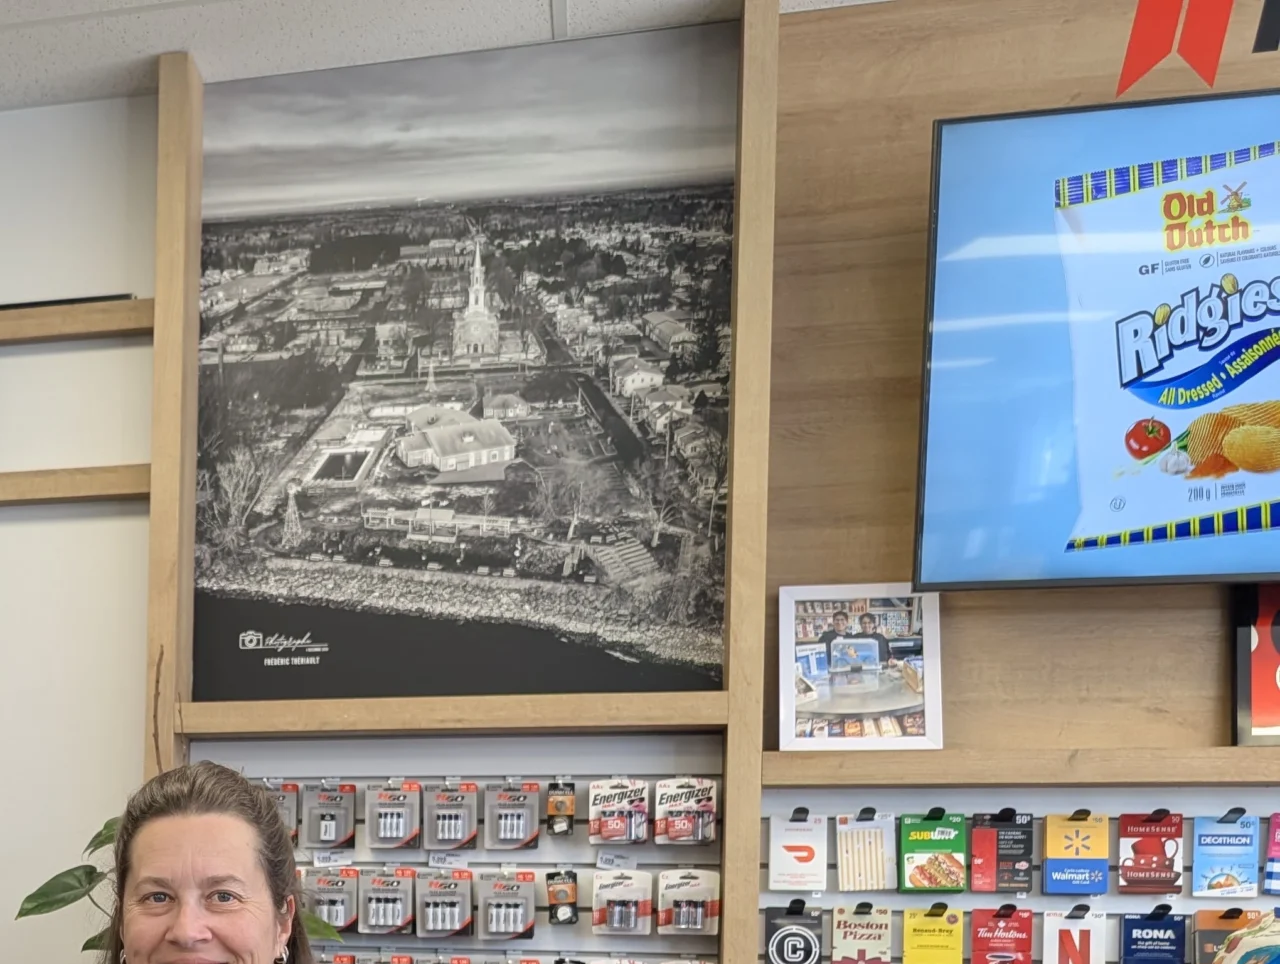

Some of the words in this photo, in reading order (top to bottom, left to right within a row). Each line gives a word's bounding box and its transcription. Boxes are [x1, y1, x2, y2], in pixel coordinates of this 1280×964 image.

[1163, 190, 1215, 221] Old
[1164, 215, 1250, 251] Dutch
[1138, 262, 1160, 276] GF
[1158, 387, 1176, 406] All
[1178, 373, 1224, 404] Dressed
[1188, 487, 1205, 502] 200
[591, 786, 646, 807] Energizer
[658, 785, 713, 806] Energizer
[1201, 836, 1251, 845] DECATHLON
[1052, 871, 1090, 881] Walmart
[836, 919, 889, 931] Boston
[842, 931, 884, 941] Pizza
[977, 927, 994, 939] Tim
[1132, 928, 1176, 939] RONA
